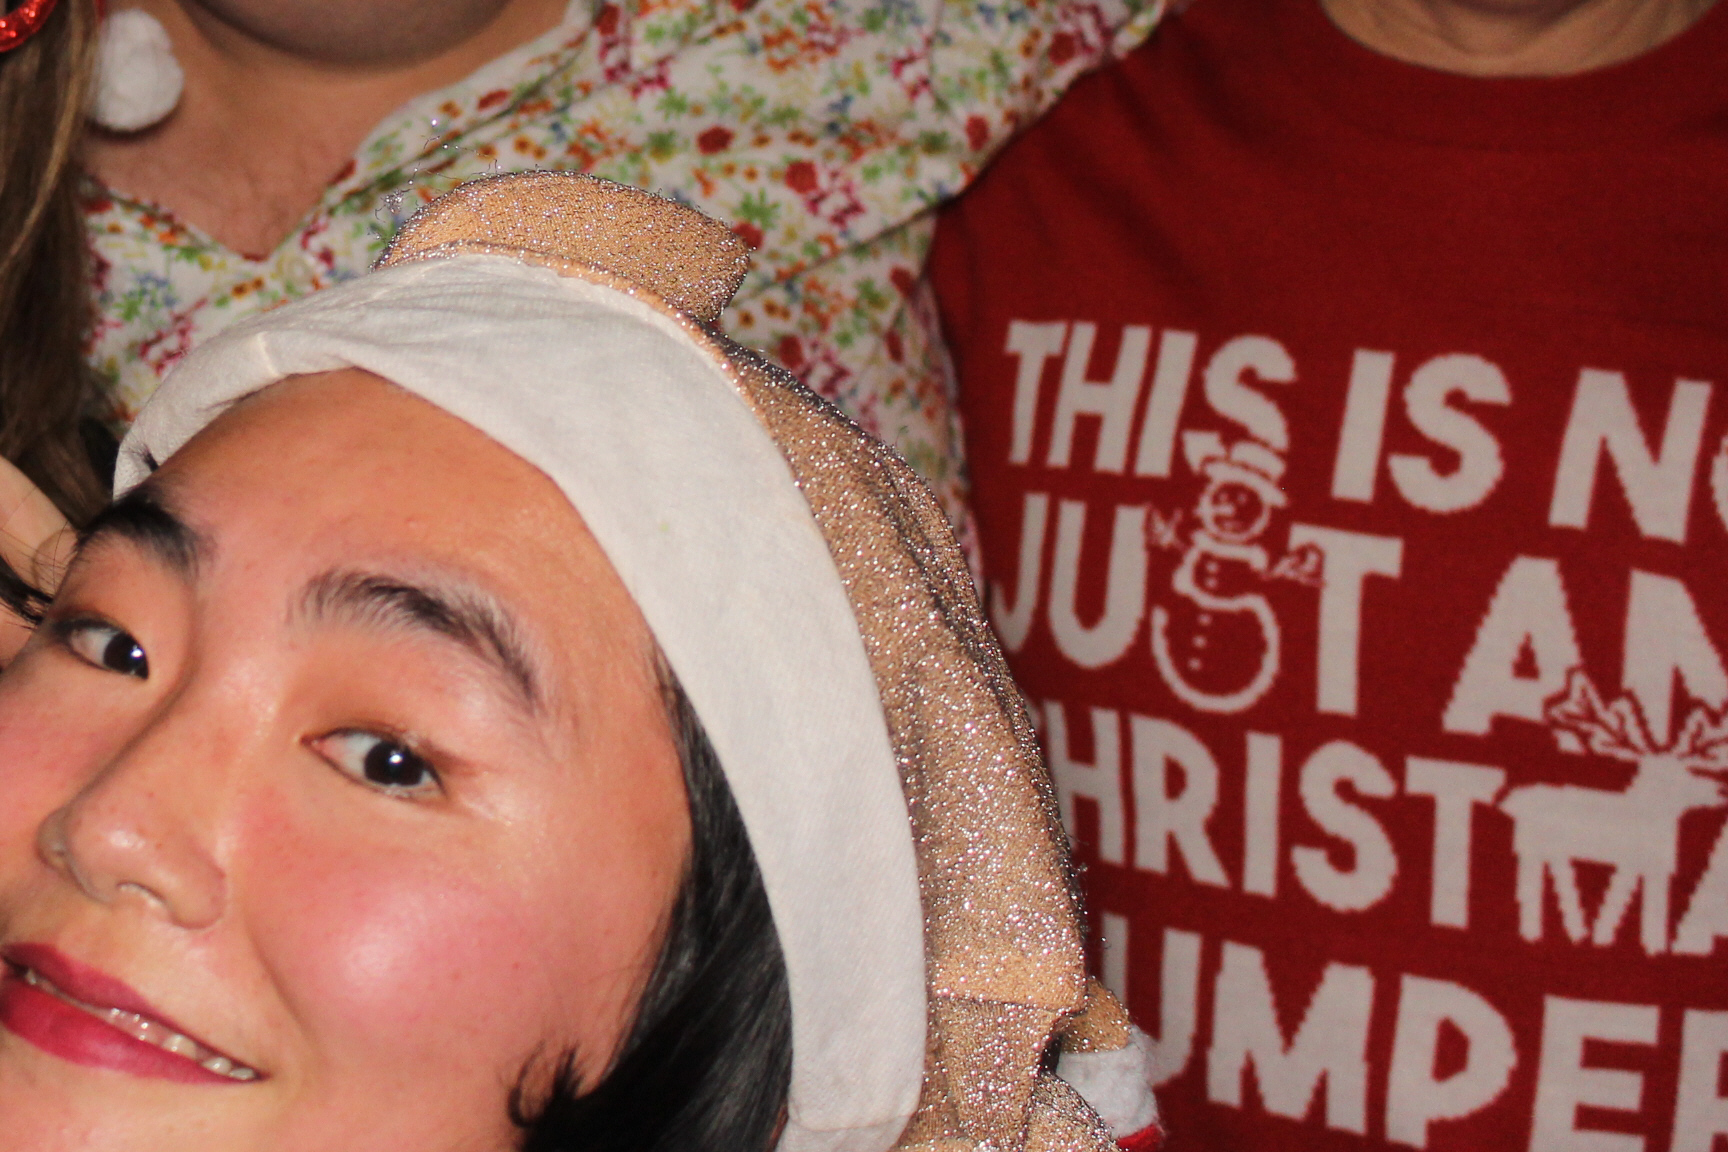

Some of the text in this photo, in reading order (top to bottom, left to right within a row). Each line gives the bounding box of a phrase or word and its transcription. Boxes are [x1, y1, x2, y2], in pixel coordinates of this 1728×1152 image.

[1003, 319, 1728, 546] THIS IS N
[990, 489, 1405, 717] JUST
[1029, 700, 1728, 956] HRISTM
[1100, 911, 1728, 1152] UMPE
